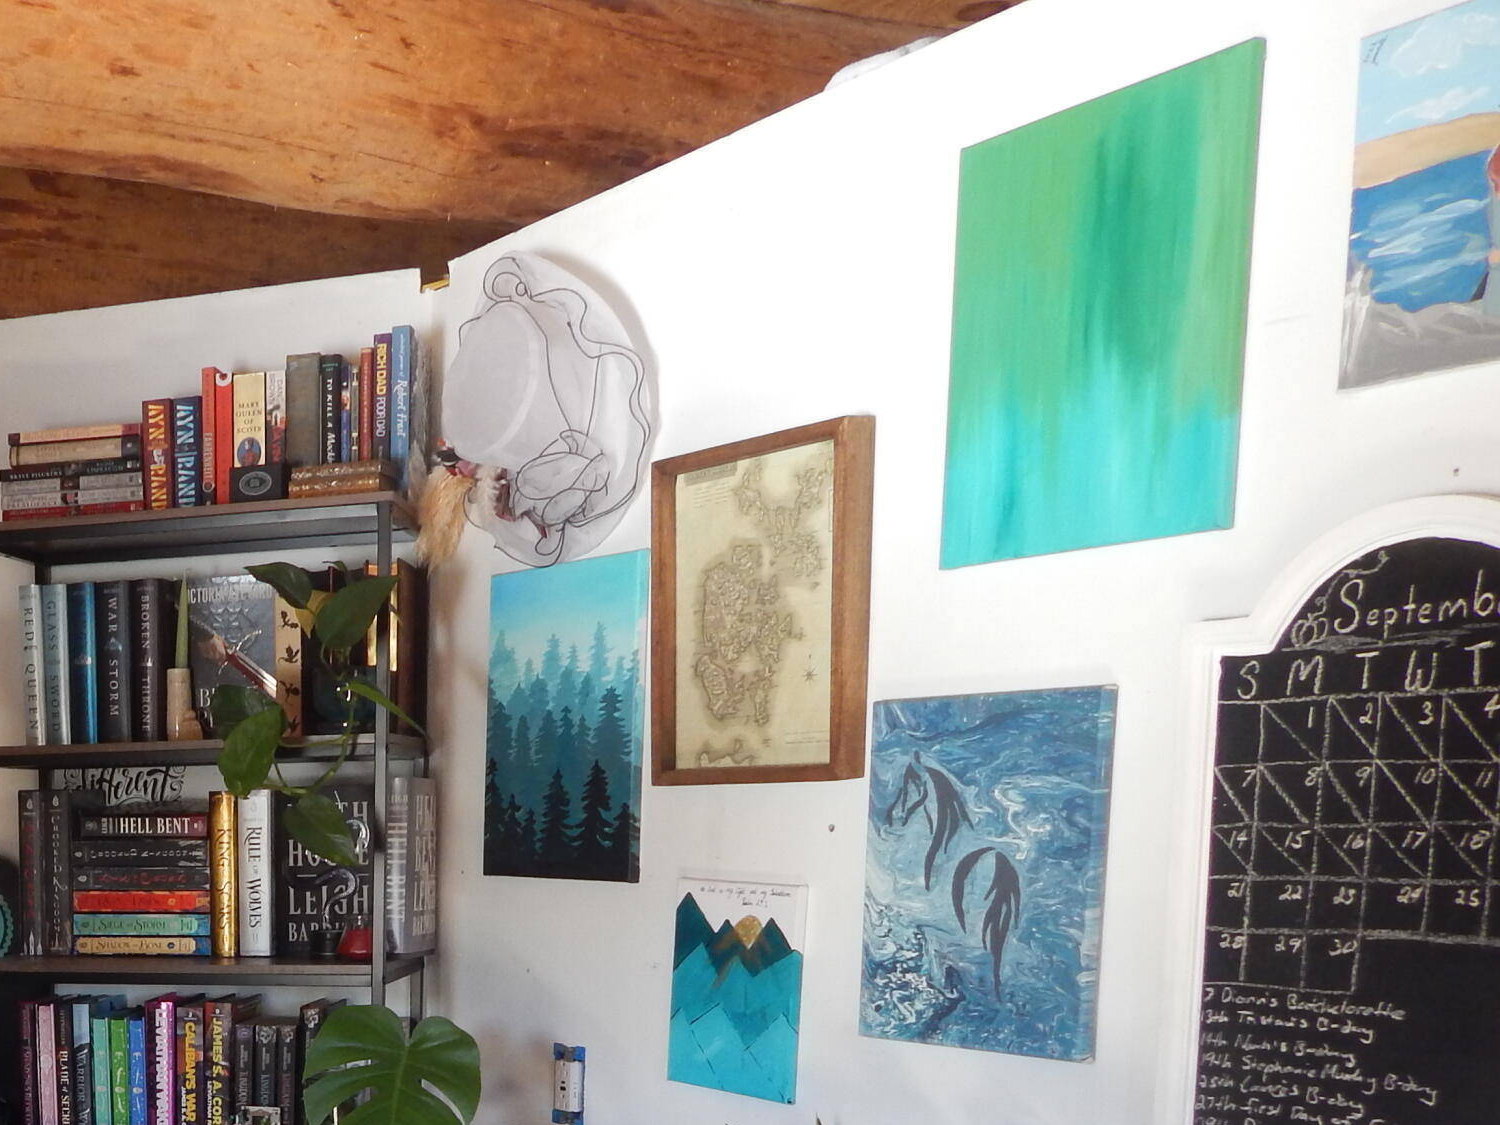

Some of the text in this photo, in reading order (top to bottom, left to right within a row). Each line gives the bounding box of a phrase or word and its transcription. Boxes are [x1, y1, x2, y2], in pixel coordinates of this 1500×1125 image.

[326, 378, 333, 391] TO
[375, 343, 387, 437] RICH DAD POOR DAD
[394, 379, 408, 414] Robert
[148, 404, 164, 440] AYN
[235, 409, 262, 417] QUEEN
[238, 401, 259, 409] MARY
[177, 404, 194, 444] AYN
[237, 425, 261, 433] SCOTS
[397, 414, 406, 438] Frost
[24, 607, 38, 730] RED QUEEN
[47, 600, 60, 732] GLASS SWORD
[107, 597, 119, 716] WAR STORM
[140, 595, 151, 732] BROKEN THRONE
[1237, 640, 1497, 700] S M T W T
[1308, 701, 1434, 729] 1 2 3
[1242, 765, 1494, 788] 7 8 9 10 11
[120, 817, 190, 834] HELL BENT
[1230, 828, 1490, 850] 14 15 16 17 18
[51, 815, 63, 874] CROOKED
[218, 828, 231, 868] KING
[243, 826, 262, 929] RULE WOLVES
[1228, 882, 1481, 908] 21 22 23 24 25
[288, 885, 369, 915] LEIGH
[133, 919, 167, 931] STORM
[1219, 934, 1359, 957] 28 29 30
[156, 1008, 168, 1088] LEVIATHAN
[213, 1017, 223, 1061] JAMES
[59, 1050, 70, 1085] BLADE
[76, 1048, 88, 1101] WARRIOR
[185, 1022, 197, 1122] CALIBAN'S WAR
[1201, 1051, 1438, 1107] 19th Stephanie B-day
[1305, 1086, 1366, 1119] B-day
